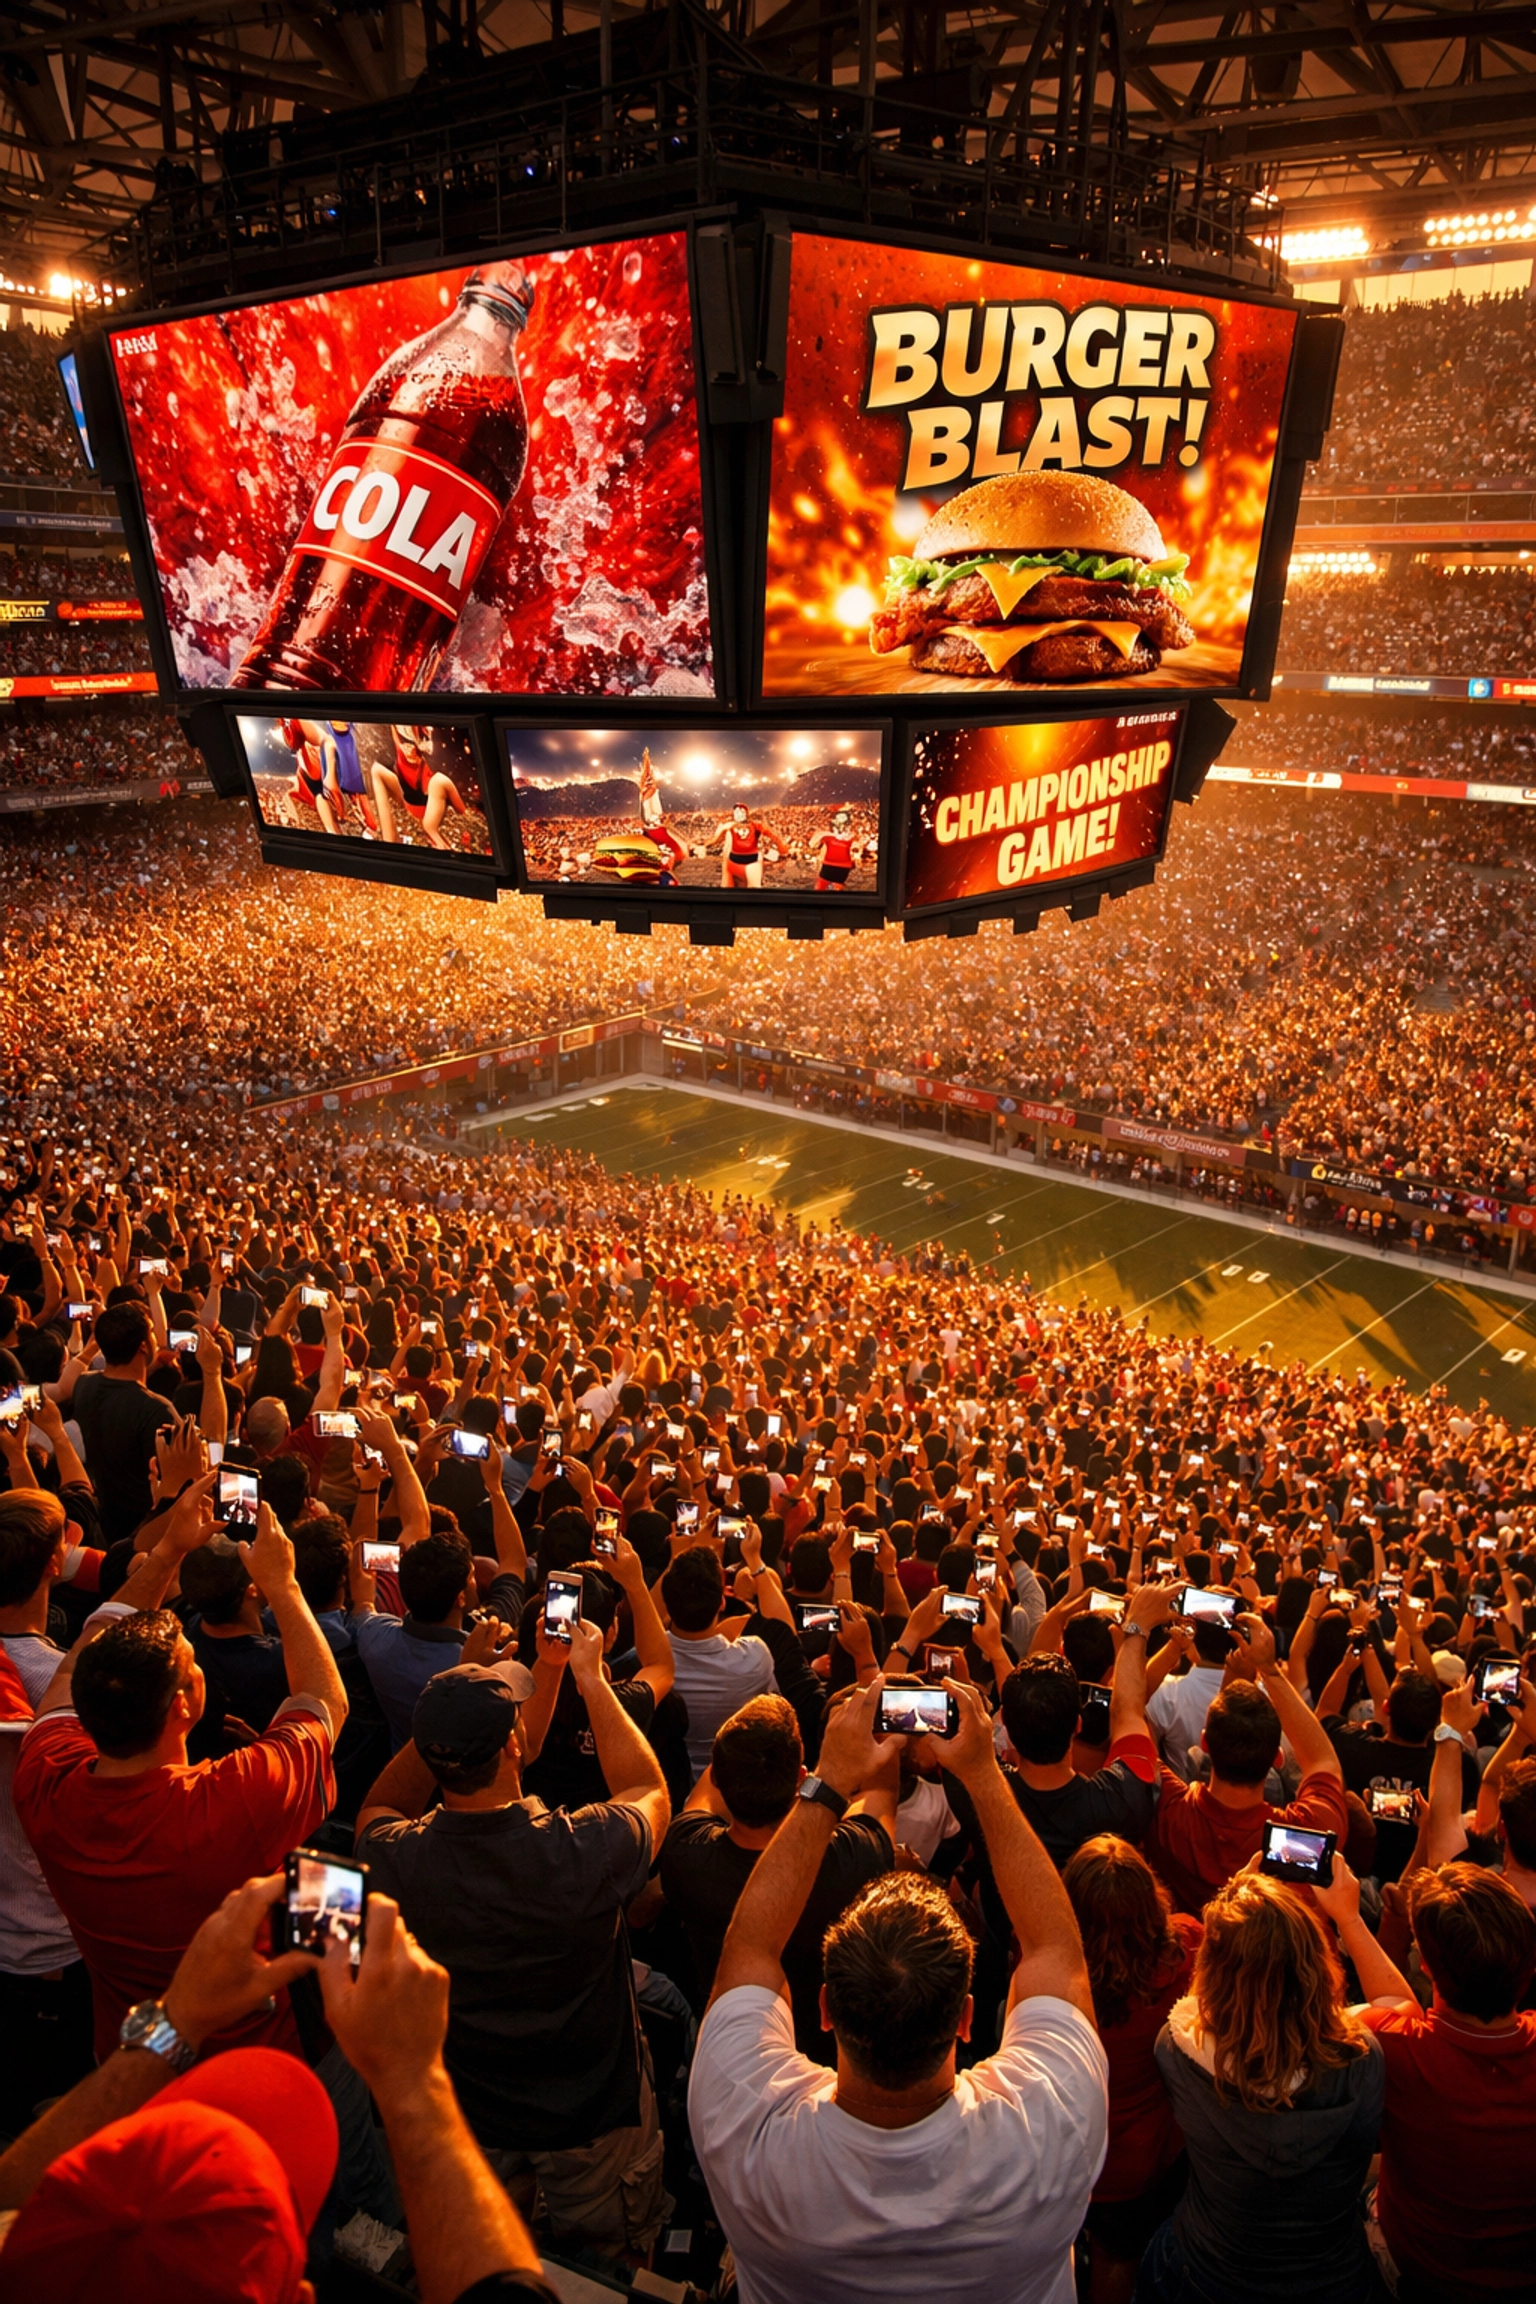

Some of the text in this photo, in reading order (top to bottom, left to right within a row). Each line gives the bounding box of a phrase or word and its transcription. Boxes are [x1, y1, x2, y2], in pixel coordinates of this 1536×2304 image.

[866, 305, 1215, 409] BURGER
[902, 396, 1209, 491] BLAST!
[313, 465, 477, 591] COLA
[935, 740, 1172, 844] CHAMPIONSHIP
[997, 802, 1122, 886] GAME!
